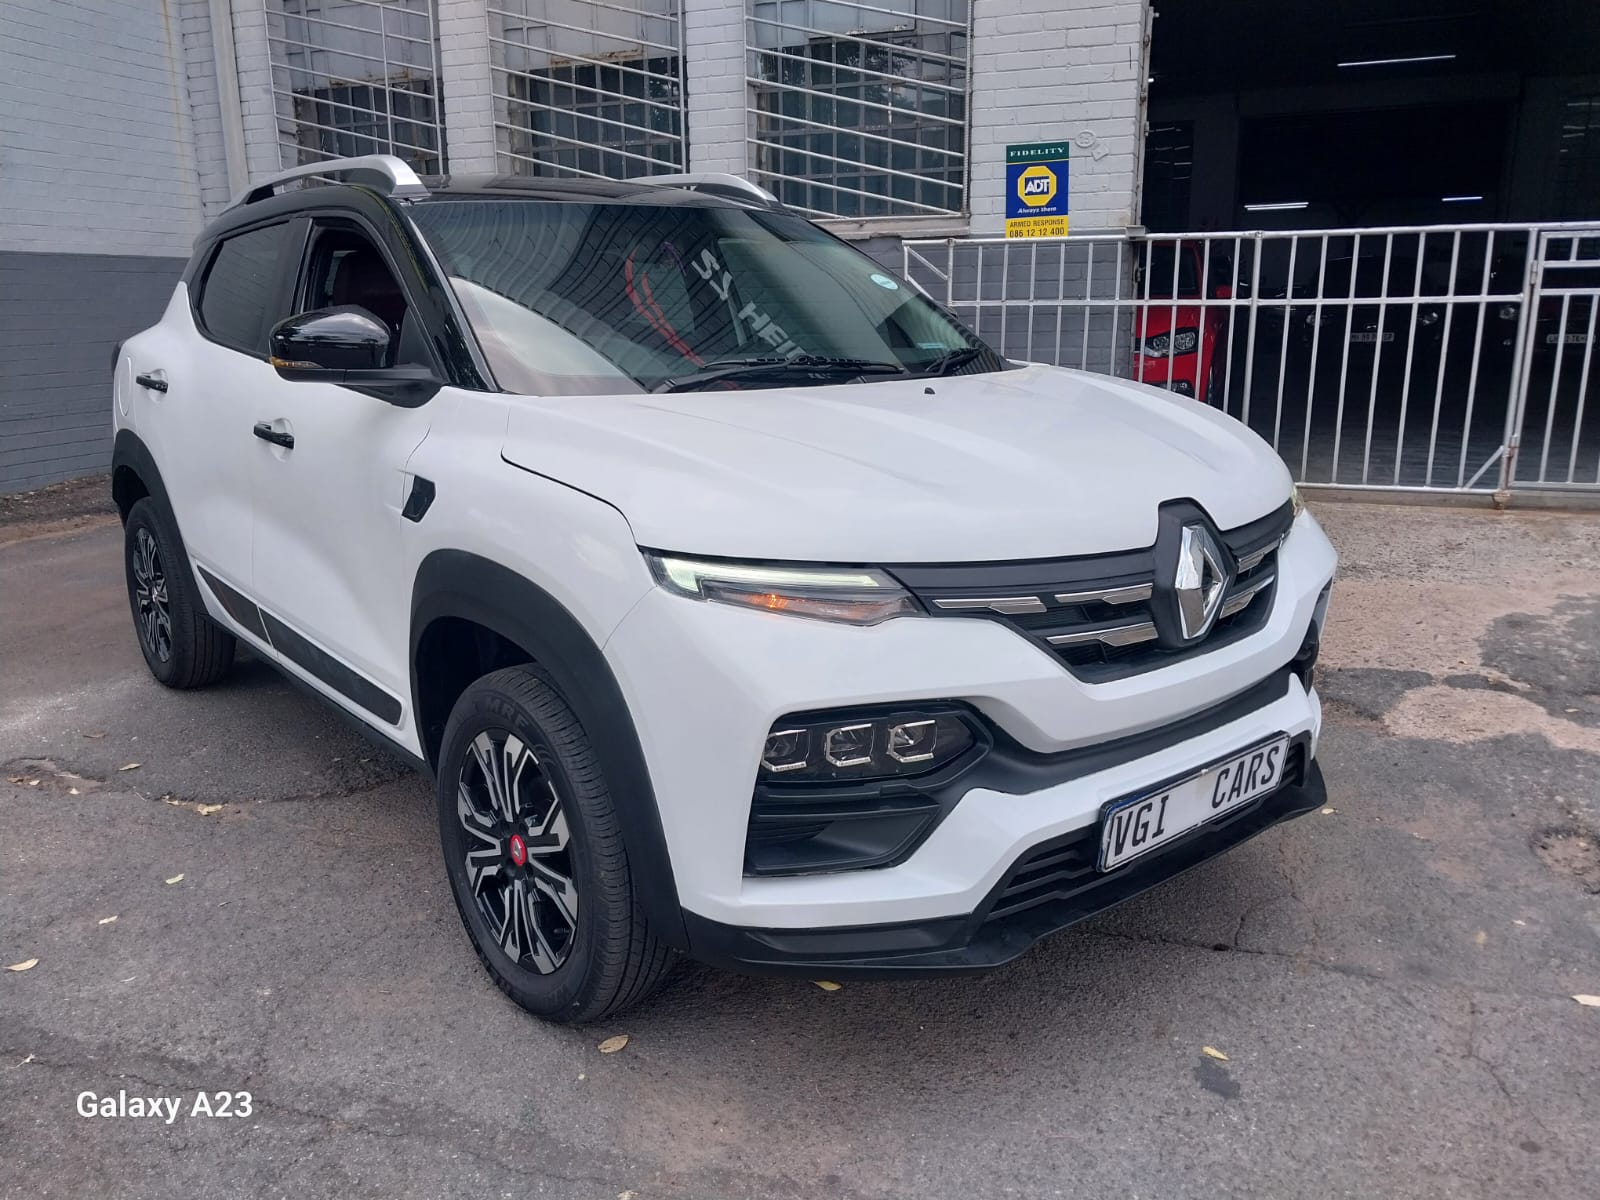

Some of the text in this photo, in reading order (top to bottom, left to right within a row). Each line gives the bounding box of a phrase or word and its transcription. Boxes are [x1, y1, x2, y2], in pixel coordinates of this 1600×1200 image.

[1010, 147, 1065, 157] FIDELITY
[1025, 179, 1050, 194] ADT
[1010, 219, 1065, 228] ARMED RESPONSE
[1010, 227, 1065, 238] 086 12 12 400
[485, 695, 530, 729] MRF
[1114, 745, 1280, 857] VGI CARS
